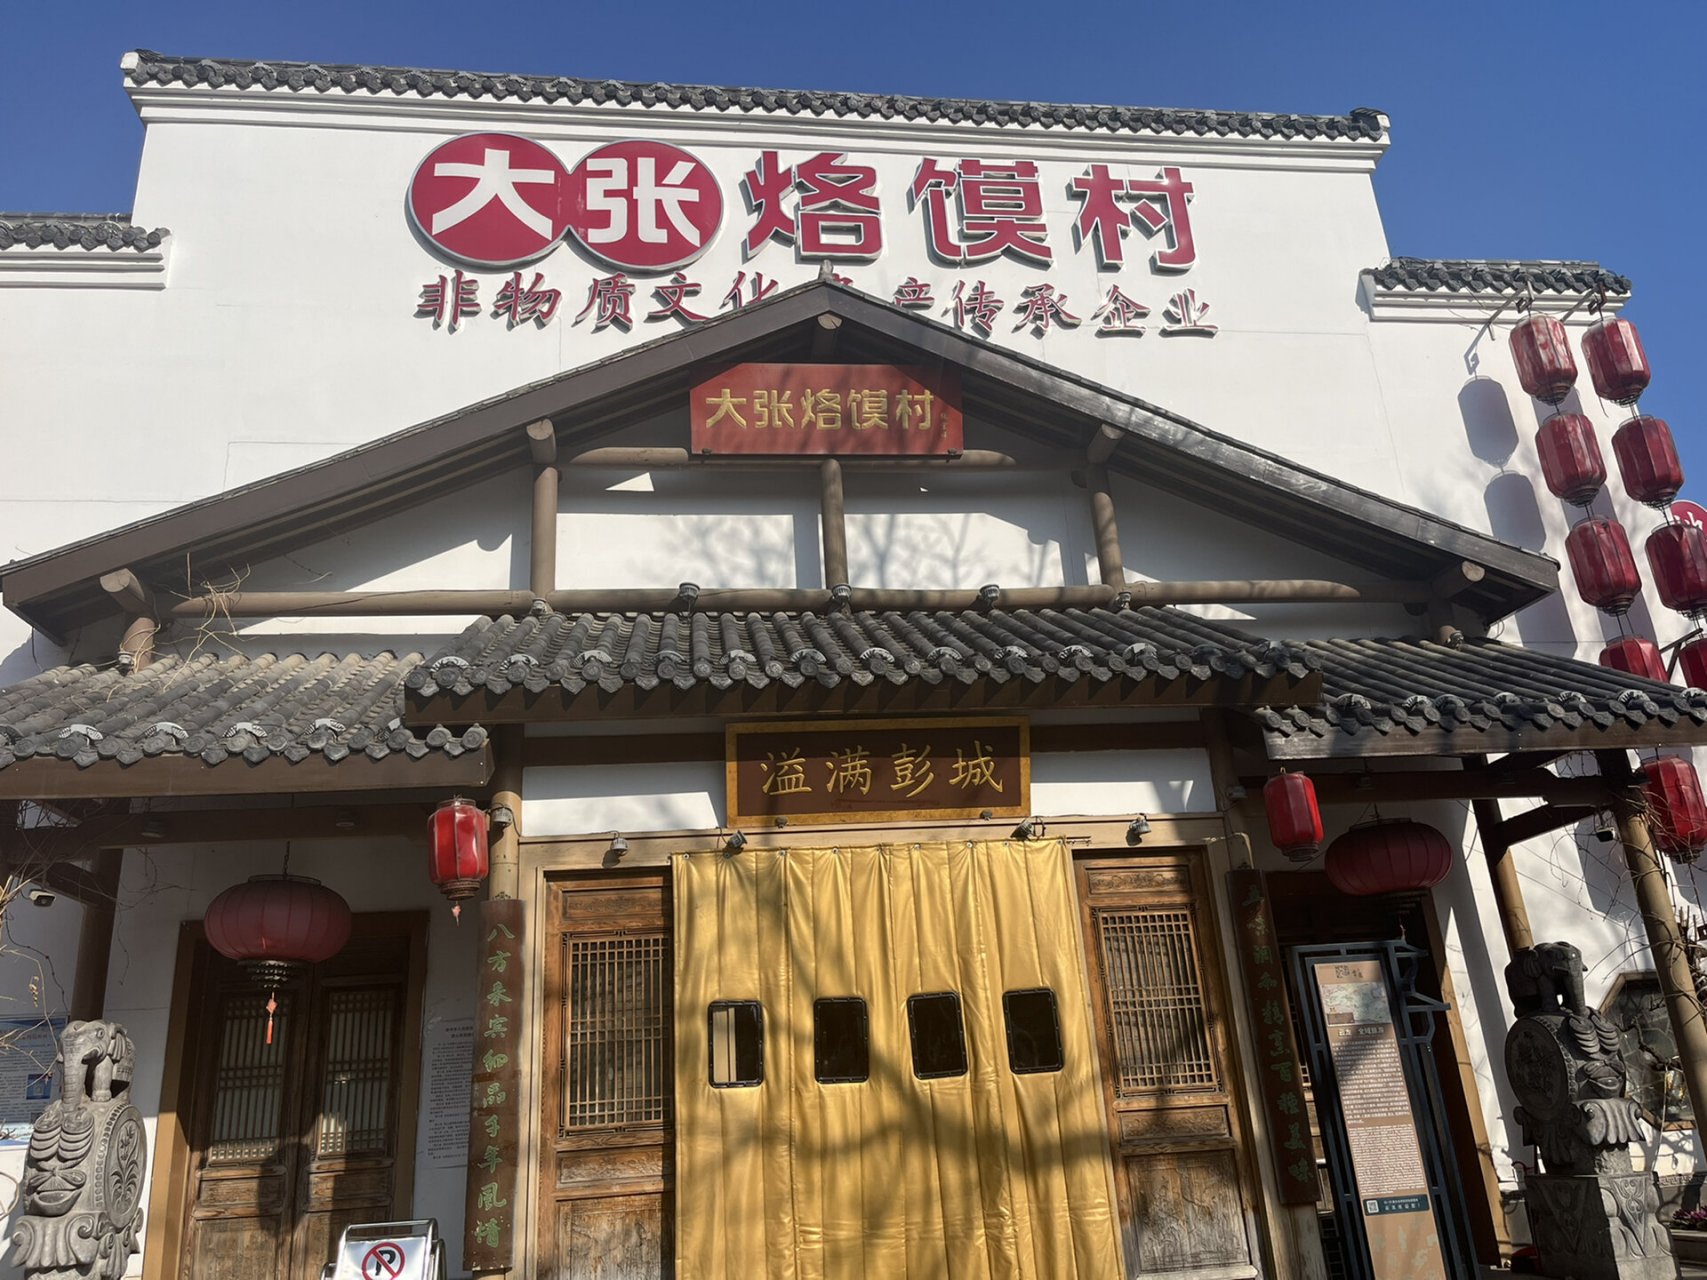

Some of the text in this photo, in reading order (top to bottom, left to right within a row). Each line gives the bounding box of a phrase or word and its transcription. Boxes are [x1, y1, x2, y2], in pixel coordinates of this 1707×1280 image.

[432, 148, 1197, 267] 大张烙馍村
[416, 269, 1218, 331] 非物质文化产传承企业
[705, 388, 934, 431] 大张烙馍村
[760, 740, 1003, 797] 溢满彭城
